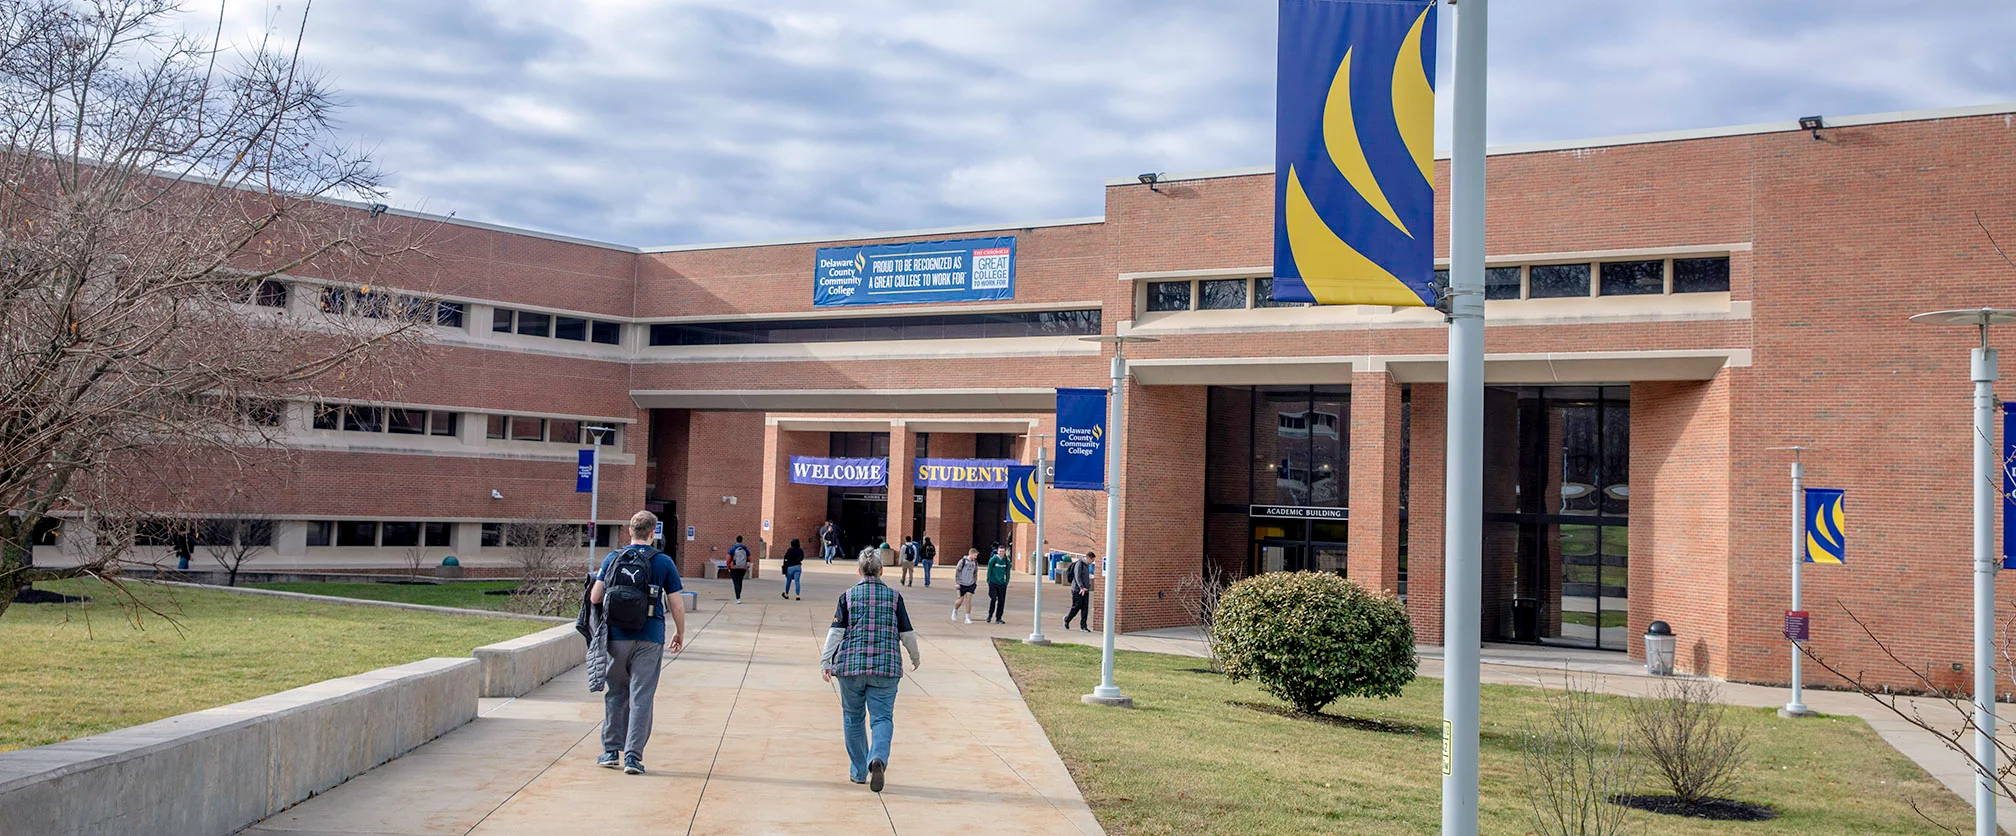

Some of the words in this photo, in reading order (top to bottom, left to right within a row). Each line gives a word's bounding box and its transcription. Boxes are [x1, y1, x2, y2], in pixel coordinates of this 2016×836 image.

[820, 258, 854, 268] Delaware
[873, 260, 893, 273] PROUD
[895, 259, 903, 272] TO
[904, 259, 912, 272] BE
[914, 257, 952, 271] RECOGNIZED
[953, 256, 962, 269] AS
[979, 257, 1007, 270] GREAT
[829, 268, 856, 277] County
[974, 270, 1007, 280] COLLEGE
[820, 276, 862, 286] Community
[868, 276, 873, 288] A
[874, 275, 893, 288] GREAT
[894, 274, 921, 288] COLLEGE
[923, 274, 931, 286] TO
[932, 273, 951, 286] WORK
[828, 286, 855, 296] College
[1060, 440, 1100, 449] Community
[1068, 447, 1093, 456] College
[793, 463, 881, 480] WELCOME
